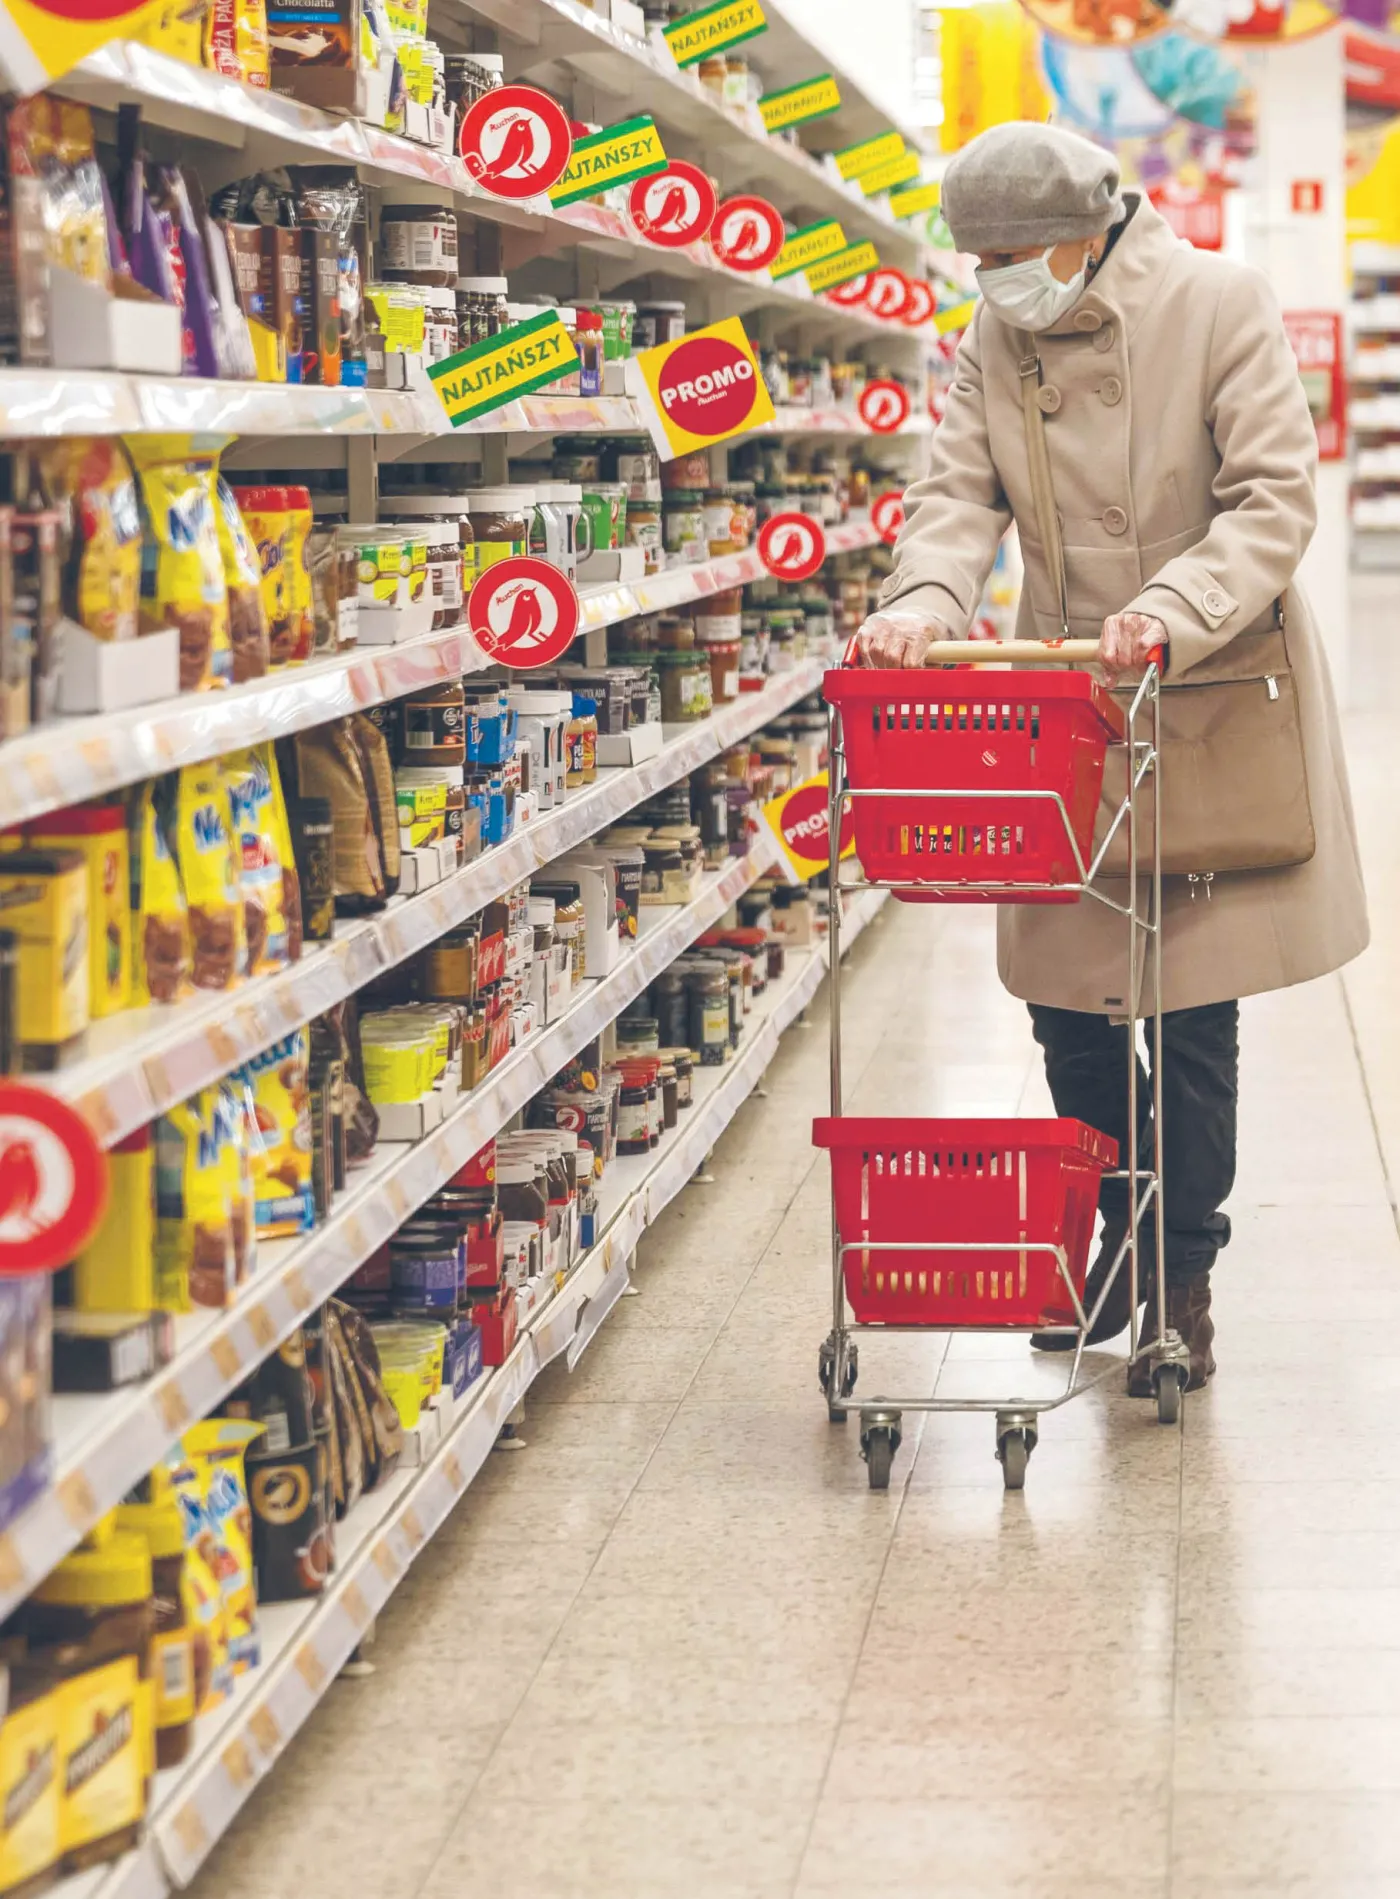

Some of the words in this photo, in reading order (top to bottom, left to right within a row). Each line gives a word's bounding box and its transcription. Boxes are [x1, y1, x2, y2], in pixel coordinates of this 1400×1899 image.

[489, 112, 520, 132] Auchan
[556, 137, 653, 186] AJTAŃSZY
[441, 334, 561, 405] NAJTAŃSZY
[661, 360, 753, 409] PROMO
[697, 390, 728, 406] Auchan
[496, 583, 524, 606] Auchan
